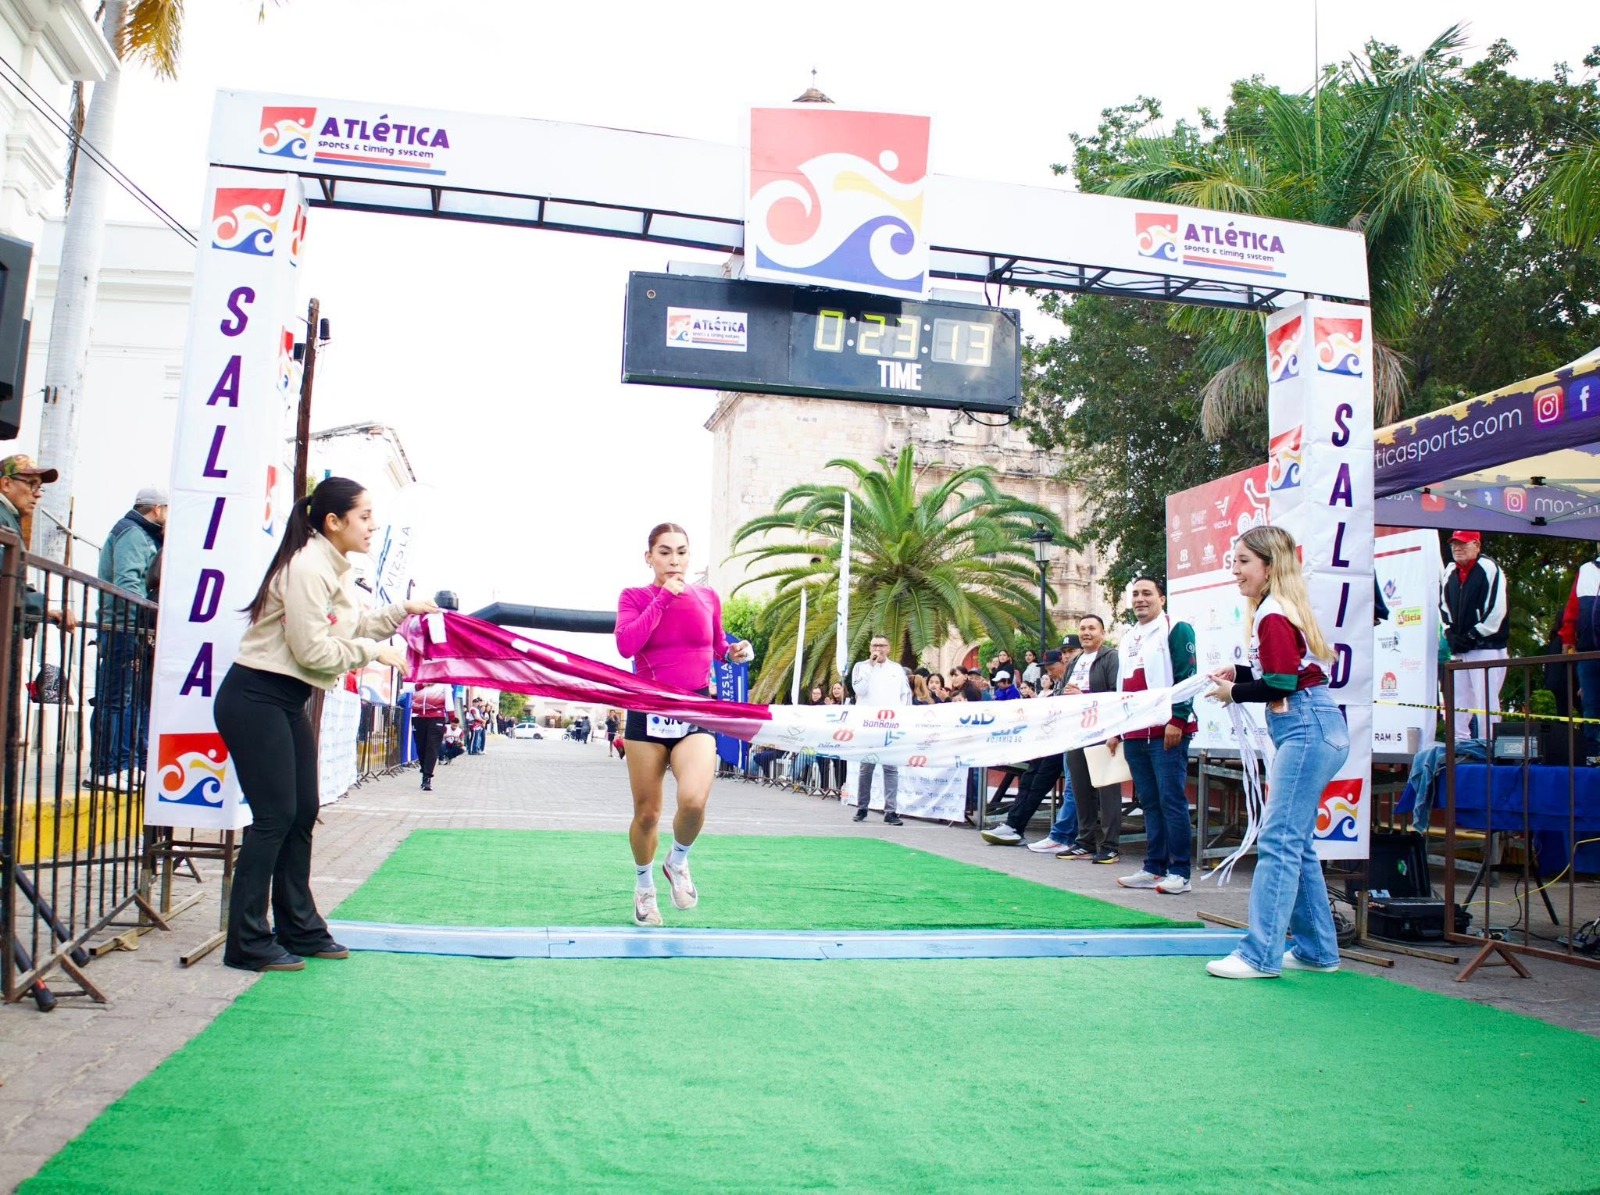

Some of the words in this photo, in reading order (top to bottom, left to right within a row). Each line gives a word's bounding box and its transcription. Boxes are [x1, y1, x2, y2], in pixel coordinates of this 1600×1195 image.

[317, 140, 350, 151] sports
[363, 143, 395, 156] timing
[398, 148, 434, 159] system
[1184, 244, 1210, 254] sports
[1219, 249, 1244, 260] timing
[1246, 252, 1275, 262] system
[817, 309, 989, 364] 0:23:13
[877, 359, 922, 391] TIME
[1375, 407, 1522, 469] ticasports.com
[179, 286, 256, 698] SALIDA
[1328, 403, 1353, 726] SALID
[720, 663, 730, 702] IZSLA
